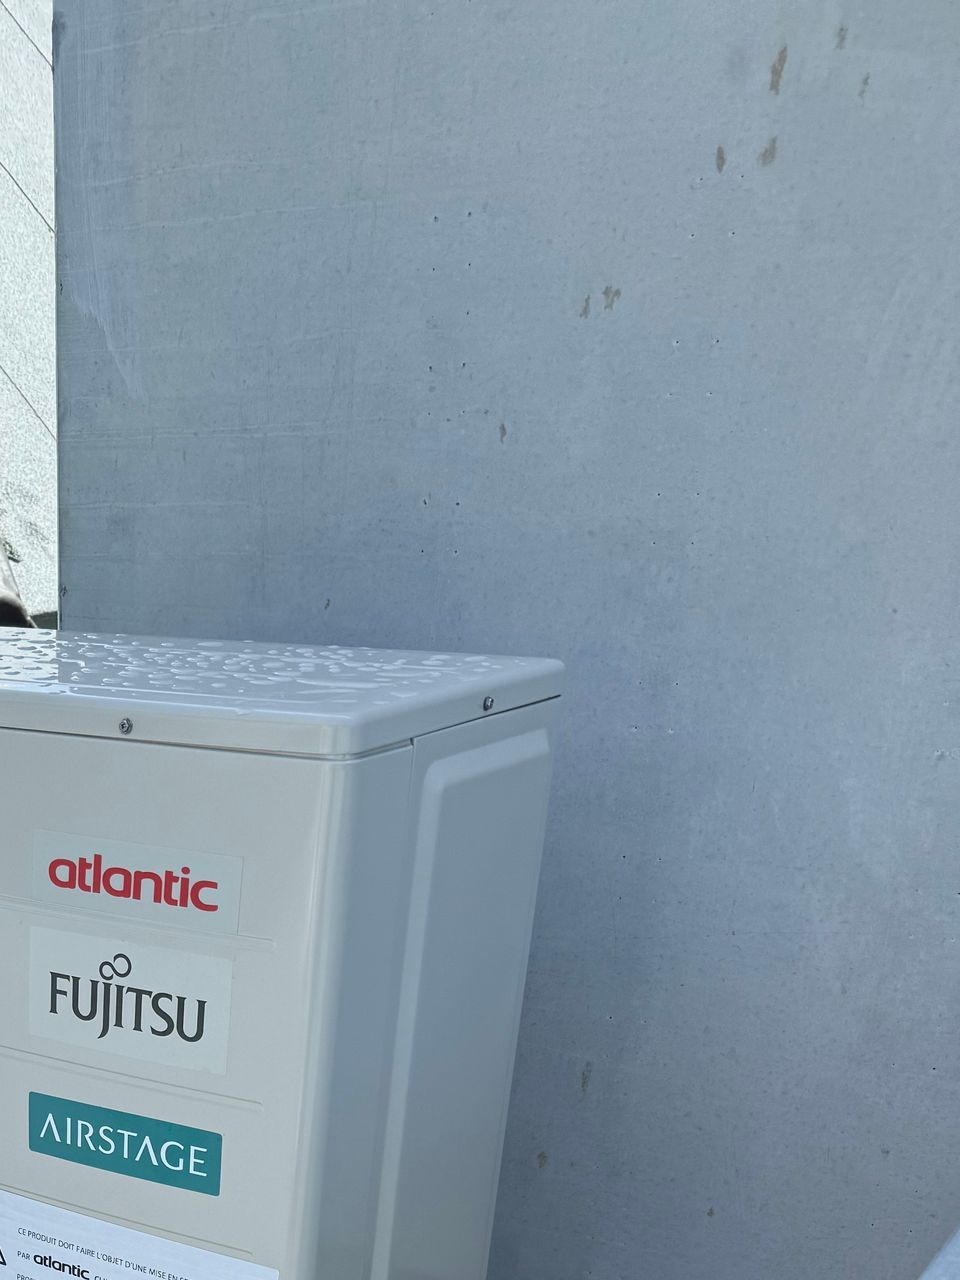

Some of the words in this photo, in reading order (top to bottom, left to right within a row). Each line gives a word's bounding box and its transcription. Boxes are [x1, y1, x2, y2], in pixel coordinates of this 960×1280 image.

[48, 854, 218, 912] atlantic
[49, 953, 207, 1042] FUJITSU
[40, 1113, 208, 1177] AIRSTAGE
[17, 1227, 26, 1235] CE
[27, 1230, 56, 1245] PRODUIT
[58, 1239, 74, 1250] DOIT
[75, 1245, 95, 1257] FAIRE
[96, 1251, 123, 1265] L'OBJET
[124, 1260, 146, 1273] D'UNE
[148, 1267, 166, 1279] MISE
[17, 1250, 30, 1260] PAR
[32, 1254, 90, 1280] atlantic
